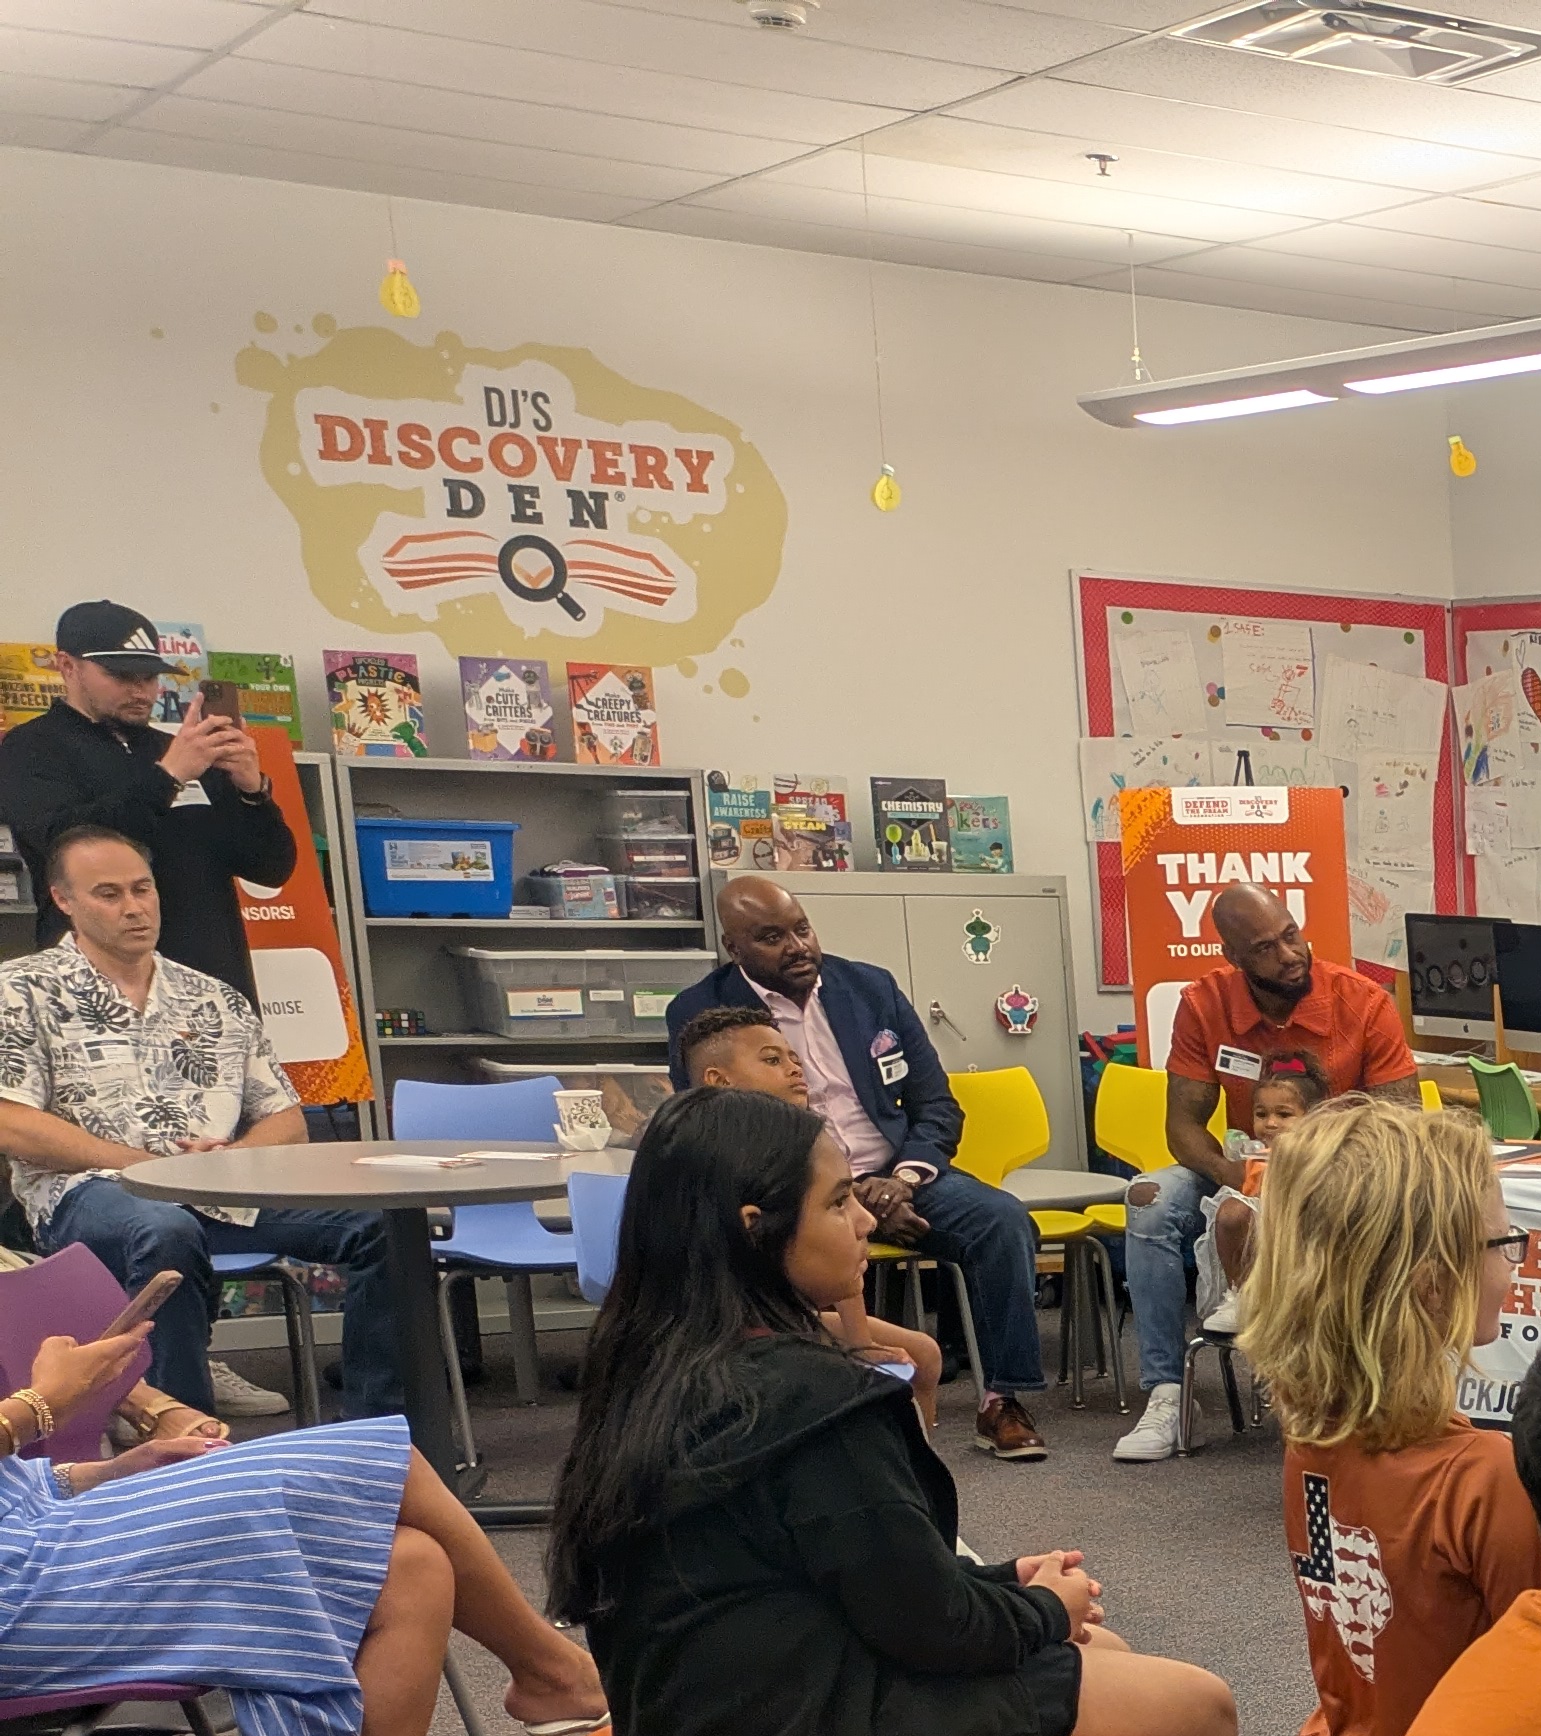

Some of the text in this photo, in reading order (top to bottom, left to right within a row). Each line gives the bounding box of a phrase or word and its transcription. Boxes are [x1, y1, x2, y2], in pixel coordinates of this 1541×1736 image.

[484, 386, 552, 432] DJ'S
[314, 413, 714, 494] DISCOVERY
[495, 693, 520, 706] CUTE
[594, 697, 631, 711] CREEPY
[485, 705, 533, 718] CRITTERS
[587, 709, 642, 723] CREATURES
[723, 793, 755, 806] RAISE
[881, 800, 943, 812] CHEMISTRY
[1184, 800, 1228, 808] DEFEND
[713, 806, 767, 818] AWARENESS
[1157, 852, 1313, 885] THANK
[1166, 889, 1306, 938] YU
[1167, 943, 1223, 957] TO OUR
[262, 1000, 304, 1016] NOISE
